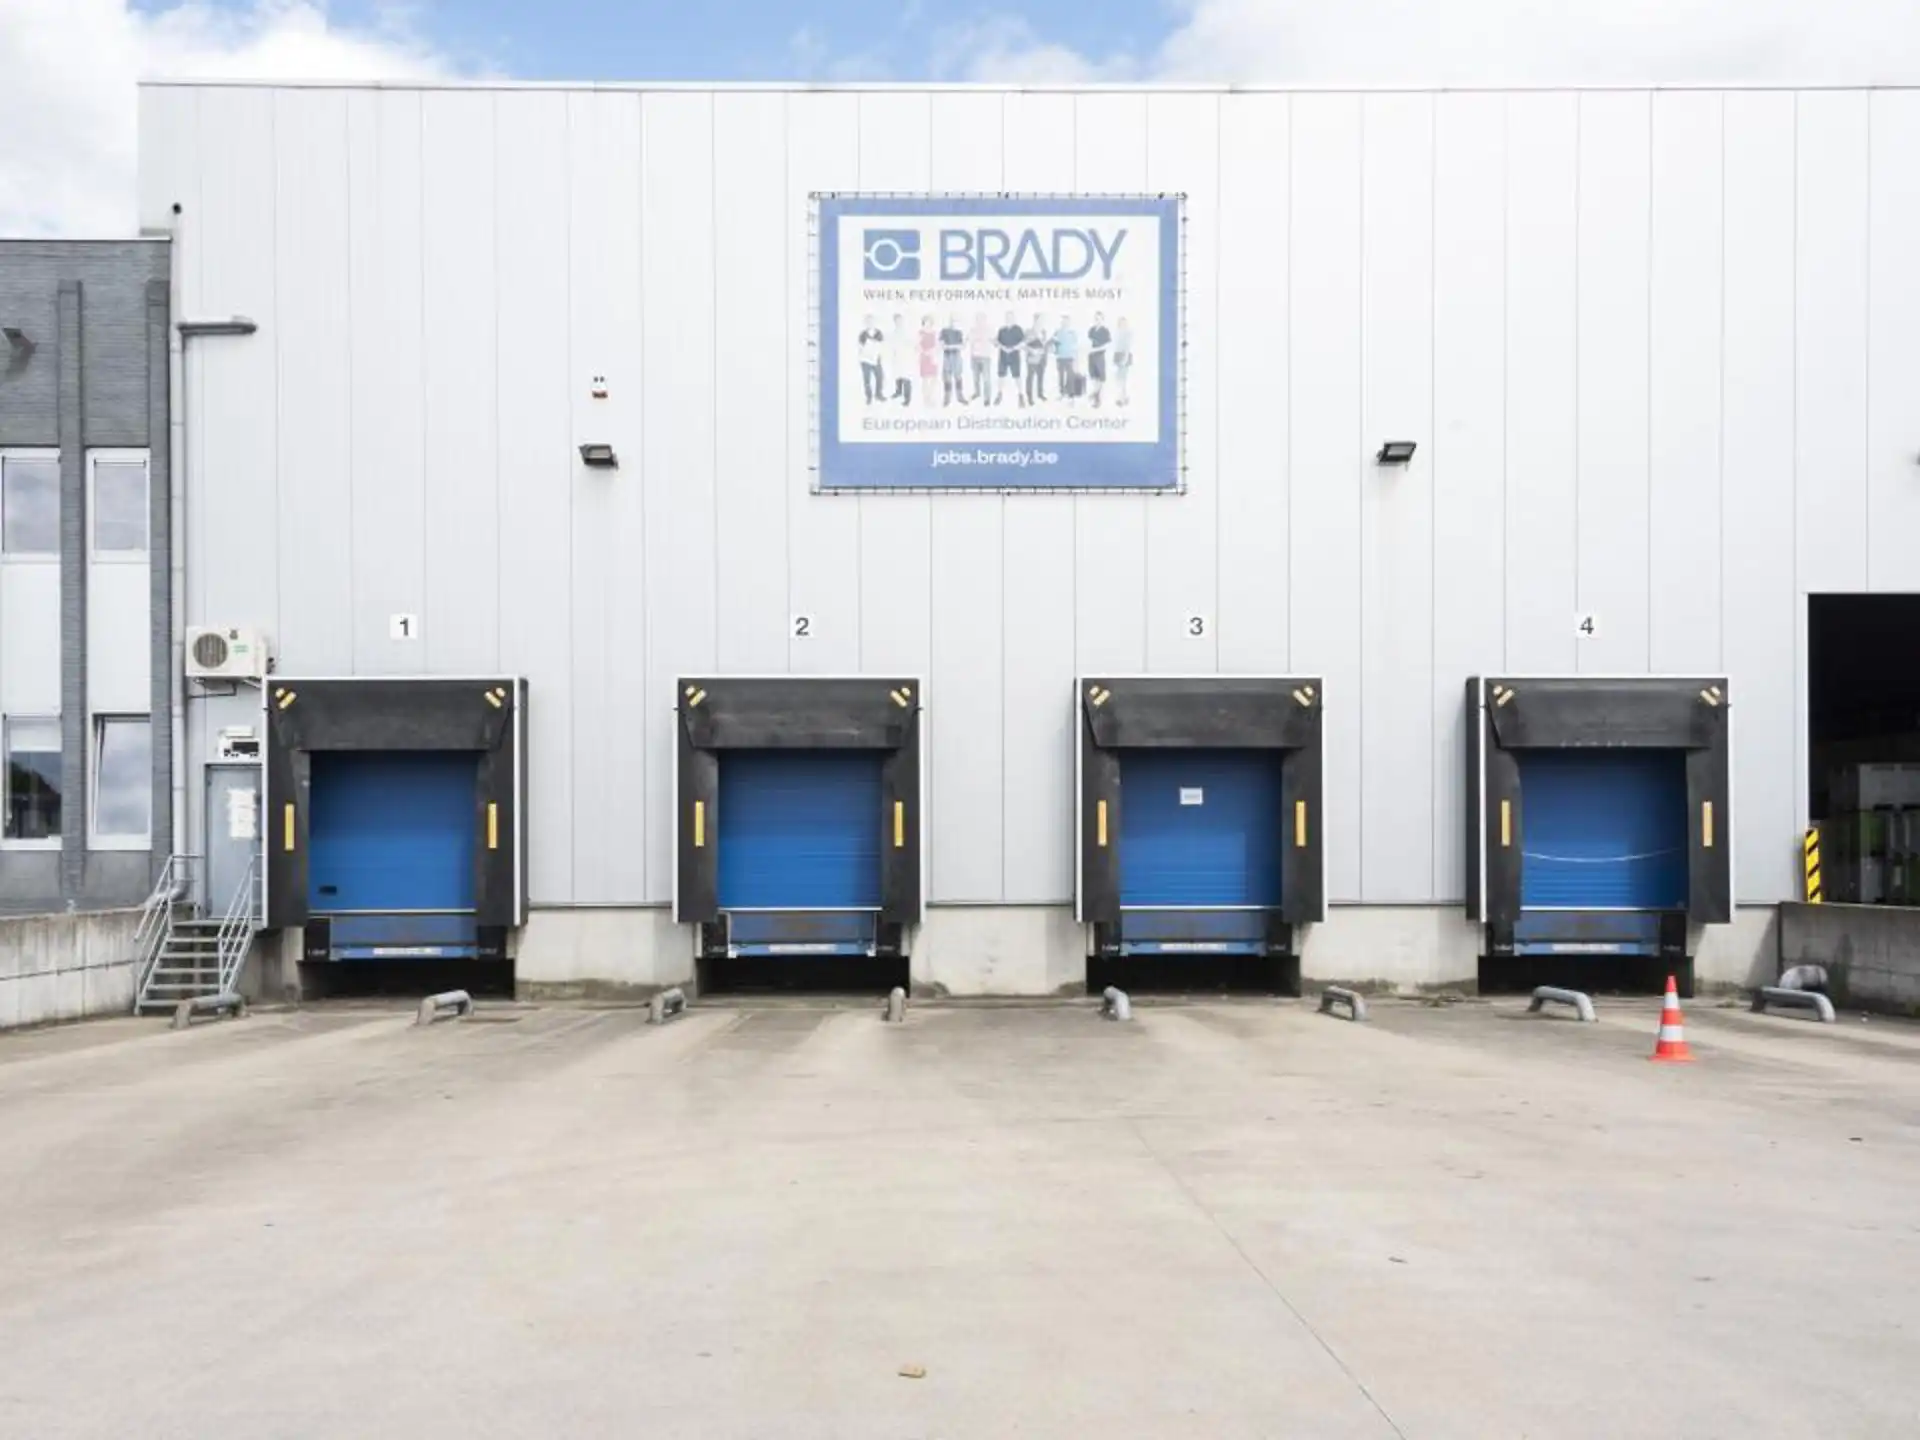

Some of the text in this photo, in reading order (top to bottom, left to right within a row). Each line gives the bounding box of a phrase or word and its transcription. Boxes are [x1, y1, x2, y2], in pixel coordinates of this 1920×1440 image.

[939, 228, 1128, 281] BRADY
[863, 287, 1123, 301] WHEN PERFORMANCE MATTERS MOST
[862, 415, 1129, 433] European Distribution Center
[931, 449, 1059, 468] jobs.brady.be
[398, 618, 410, 637] 1
[795, 617, 810, 636] 2
[1189, 617, 1204, 636] 3
[1580, 616, 1595, 635] 4
